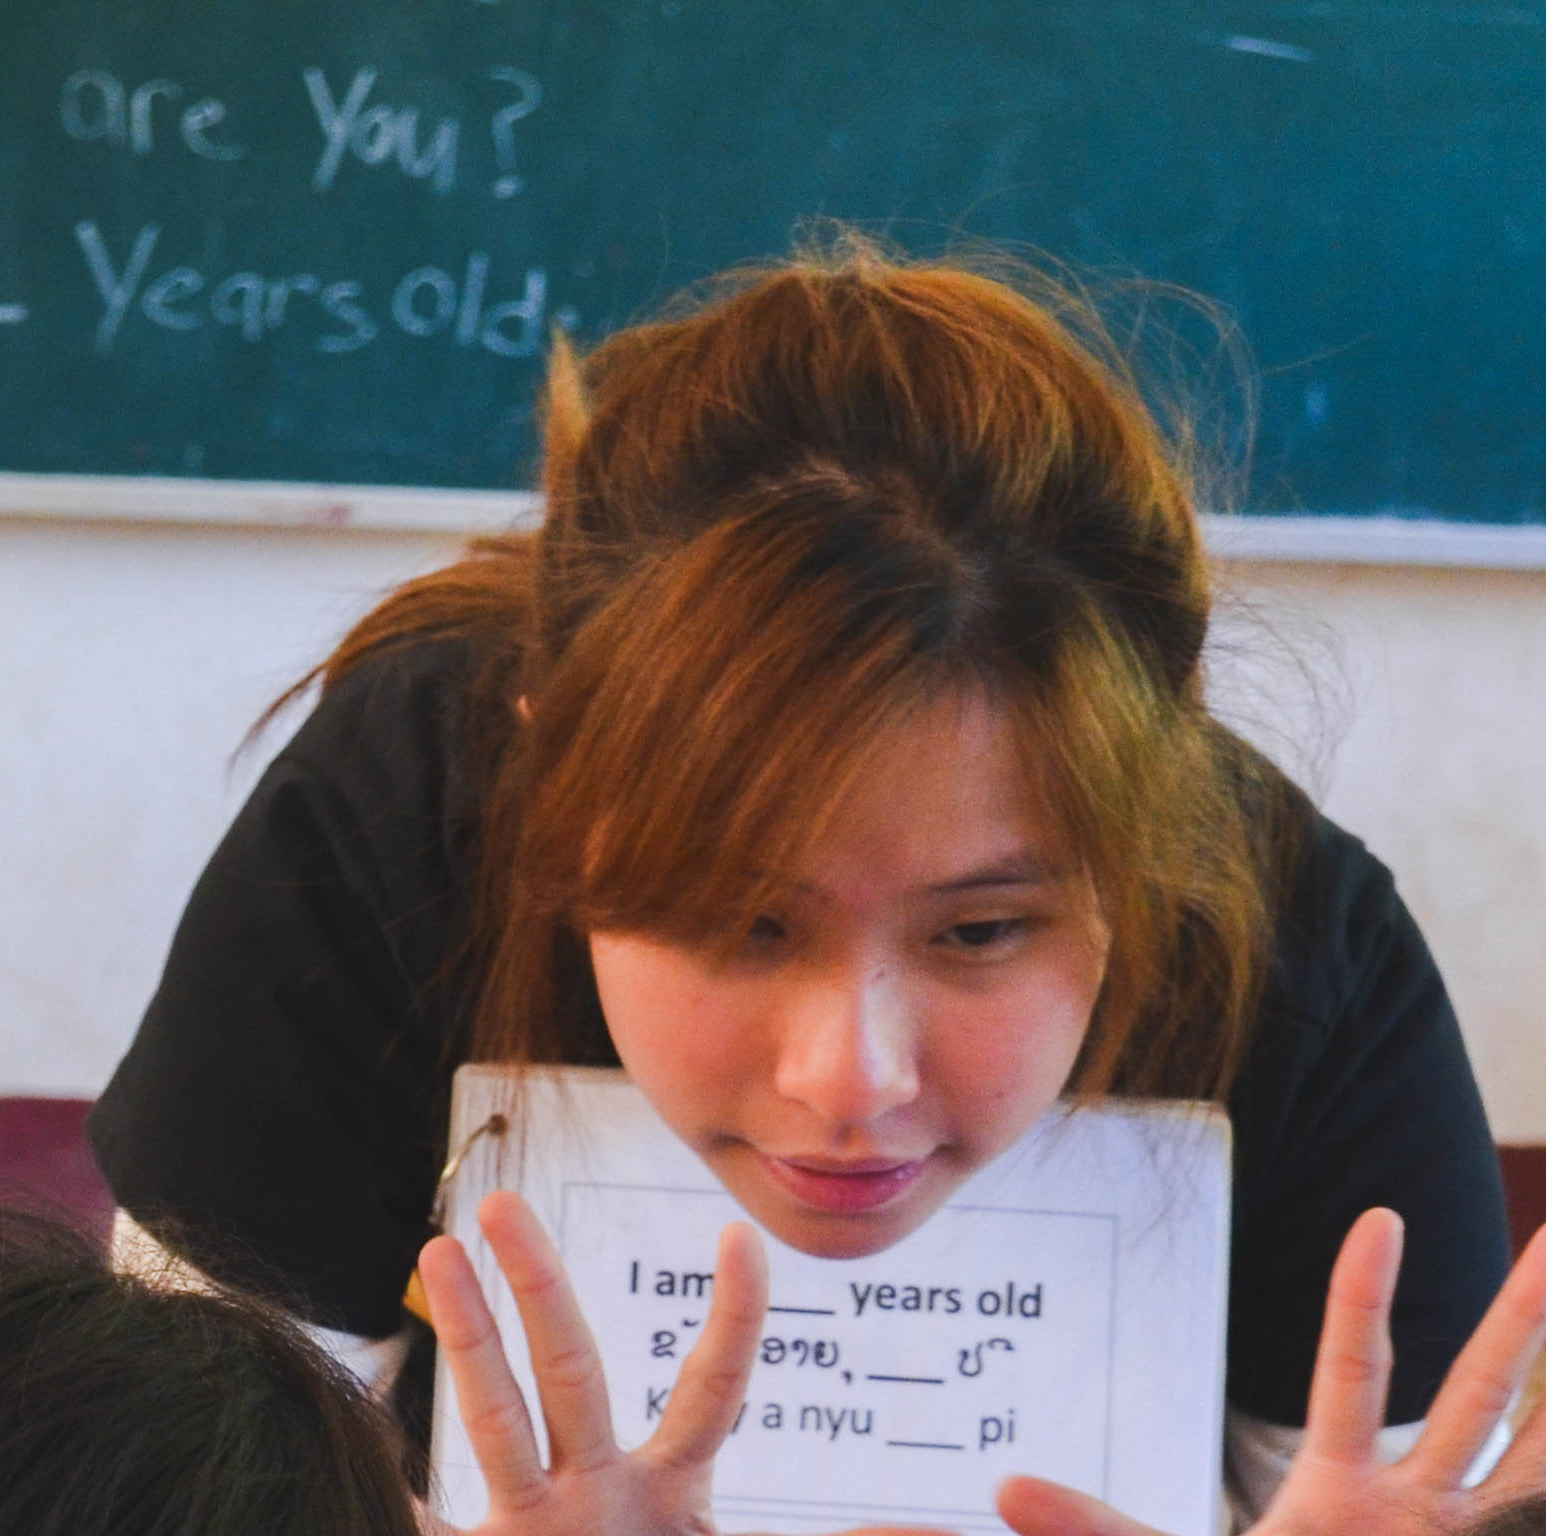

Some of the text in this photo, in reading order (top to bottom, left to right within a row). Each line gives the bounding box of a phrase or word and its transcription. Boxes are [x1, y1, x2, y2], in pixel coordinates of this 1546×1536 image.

[60, 68, 244, 160] are
[630, 1261, 1042, 1318] I am years old
[761, 1402, 783, 1430] a
[799, 1405, 873, 1441] nyu
[979, 1410, 1015, 1450] pi
